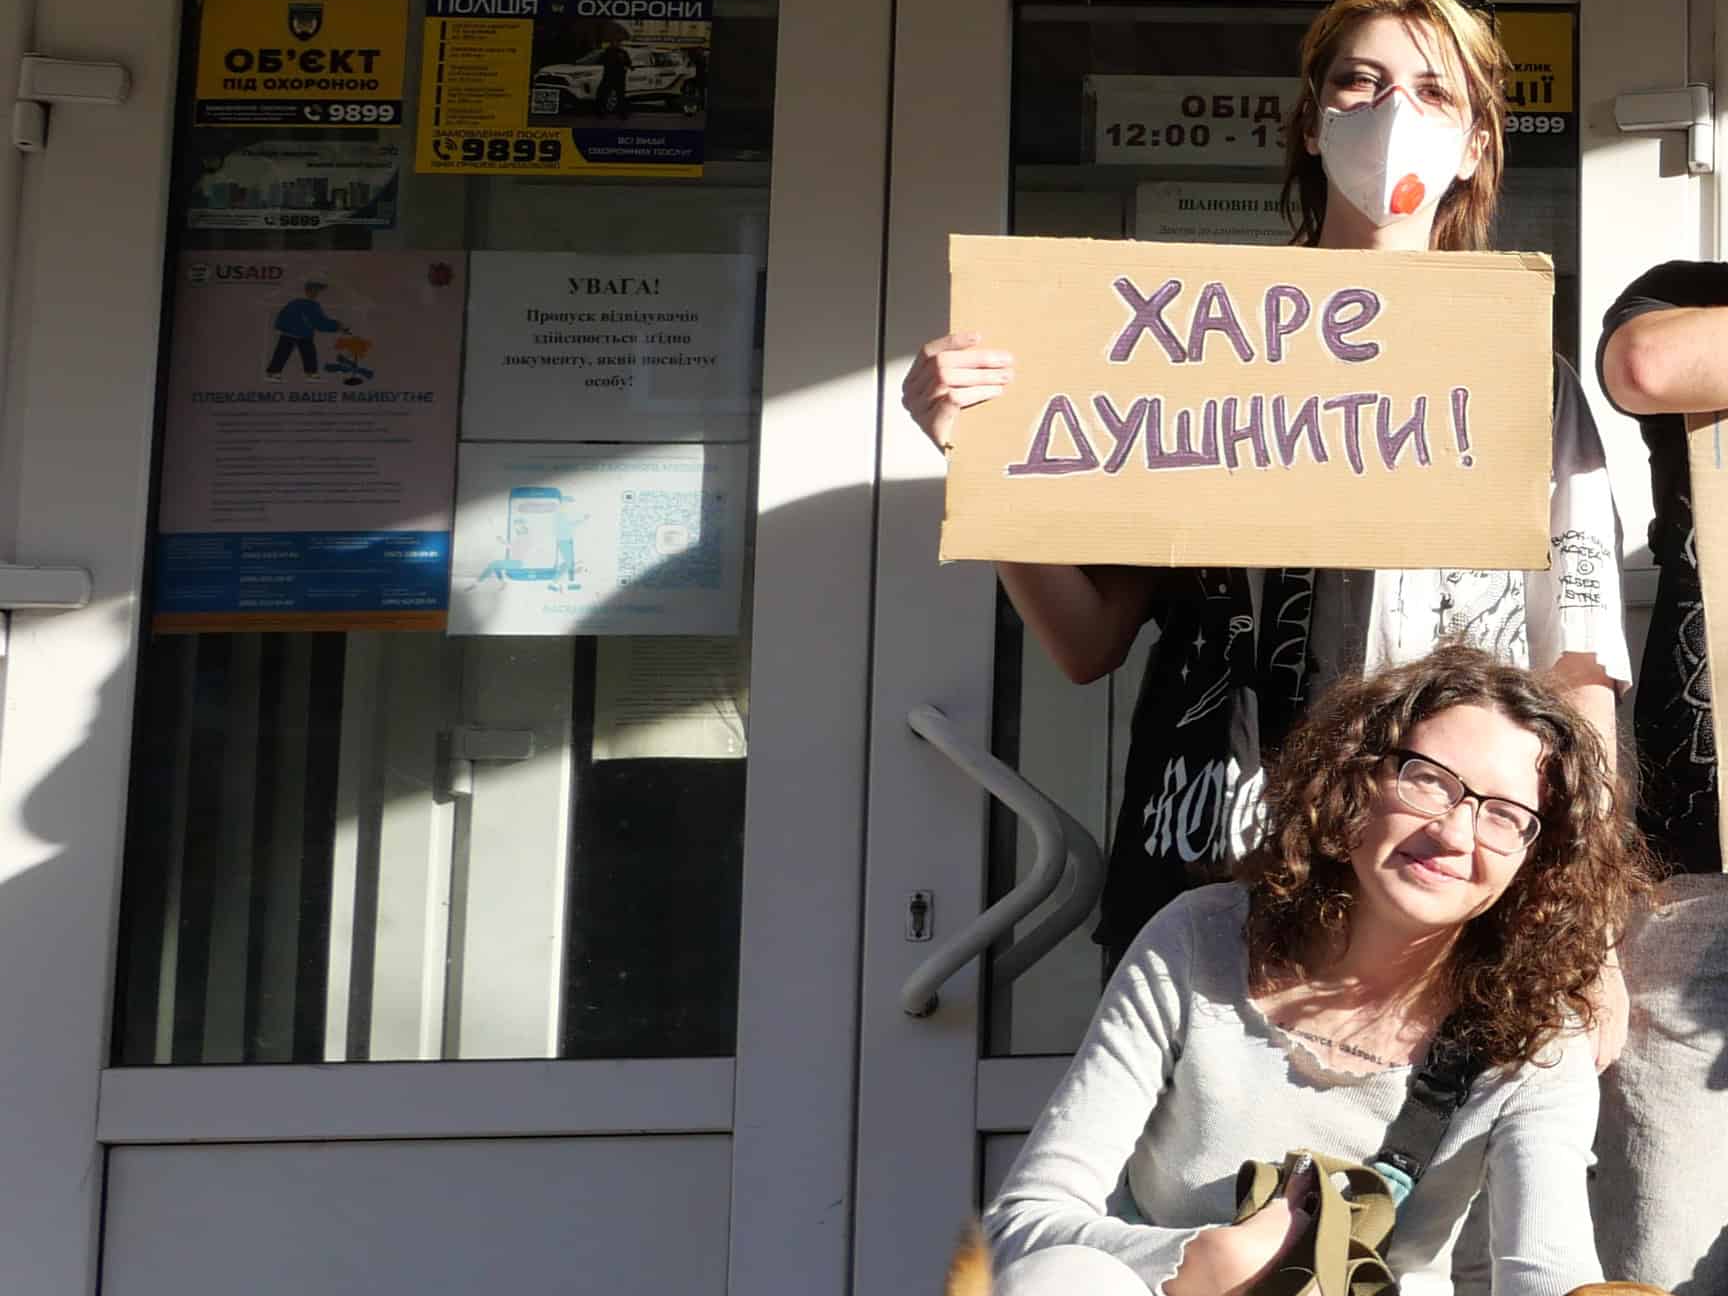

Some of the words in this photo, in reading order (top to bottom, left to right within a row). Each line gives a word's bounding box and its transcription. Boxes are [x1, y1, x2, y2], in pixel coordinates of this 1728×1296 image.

[578, 0, 703, 17] ОХОРОНИ
[223, 79, 257, 91] ПІД
[263, 79, 379, 91] ОХОРОНОЮ
[328, 105, 394, 122] 9899
[1182, 95, 1281, 123] ОБІД
[1505, 116, 1565, 133] 9899
[1106, 123, 1211, 147] 12:00
[461, 138, 561, 162] 9899
[215, 265, 284, 280] USAID
[568, 276, 660, 296] УВАГА!
[526, 307, 596, 325] Пропуск
